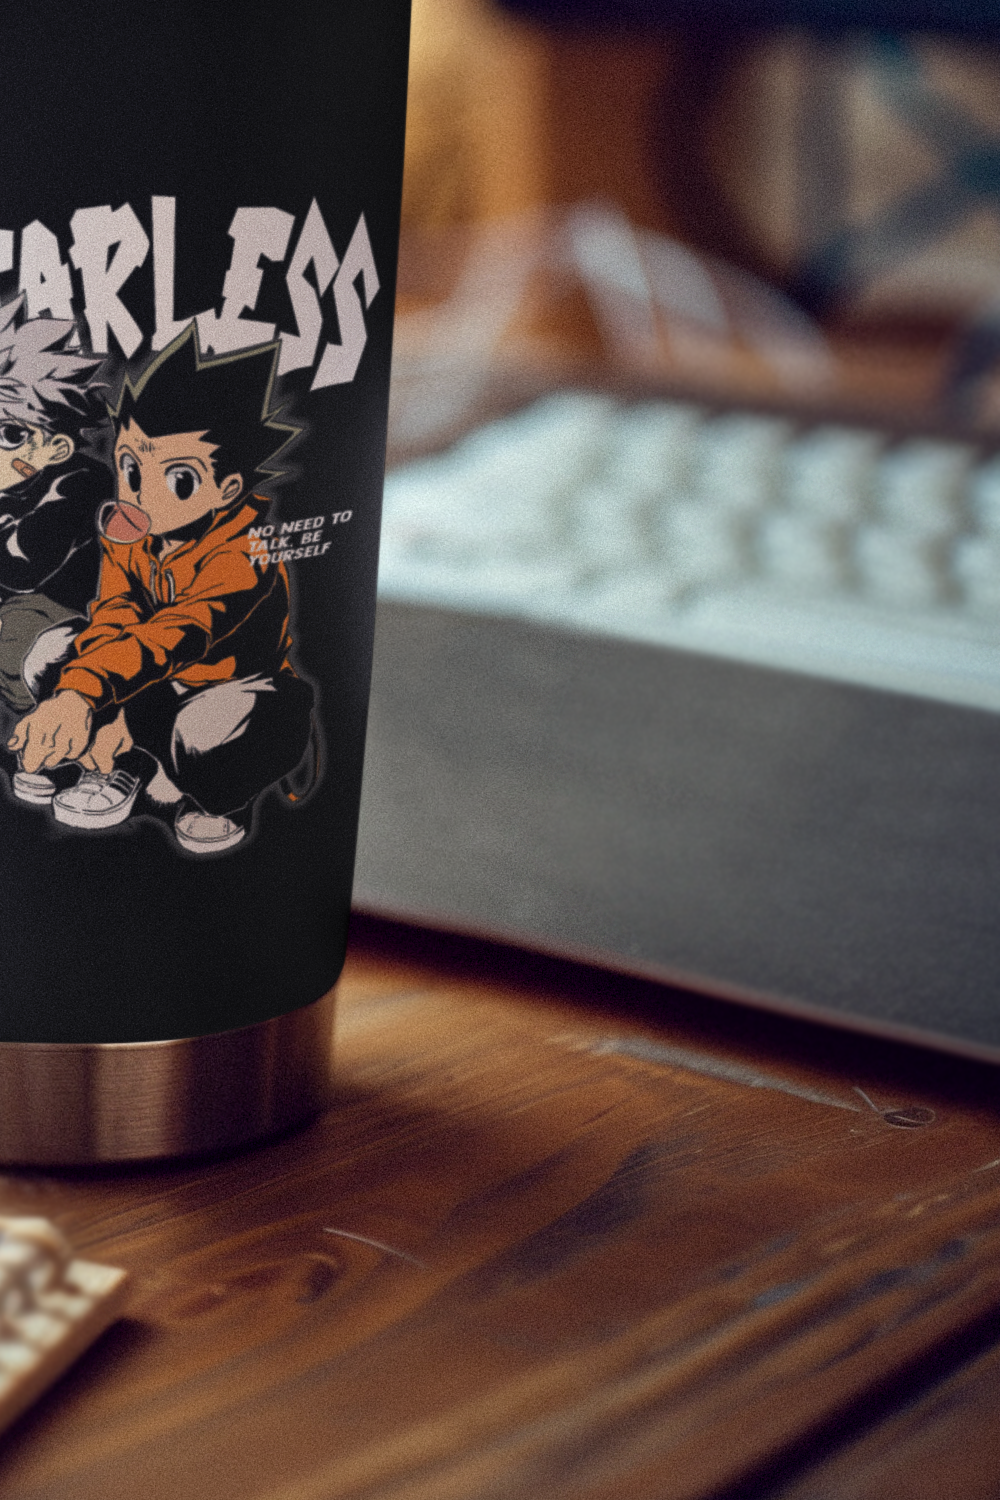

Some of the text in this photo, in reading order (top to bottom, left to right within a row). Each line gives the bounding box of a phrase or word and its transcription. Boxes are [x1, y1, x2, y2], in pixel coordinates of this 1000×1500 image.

[248, 510, 353, 540] NO NEED TO
[301, 530, 323, 545] BE
[249, 541, 332, 567] YOURSELF
